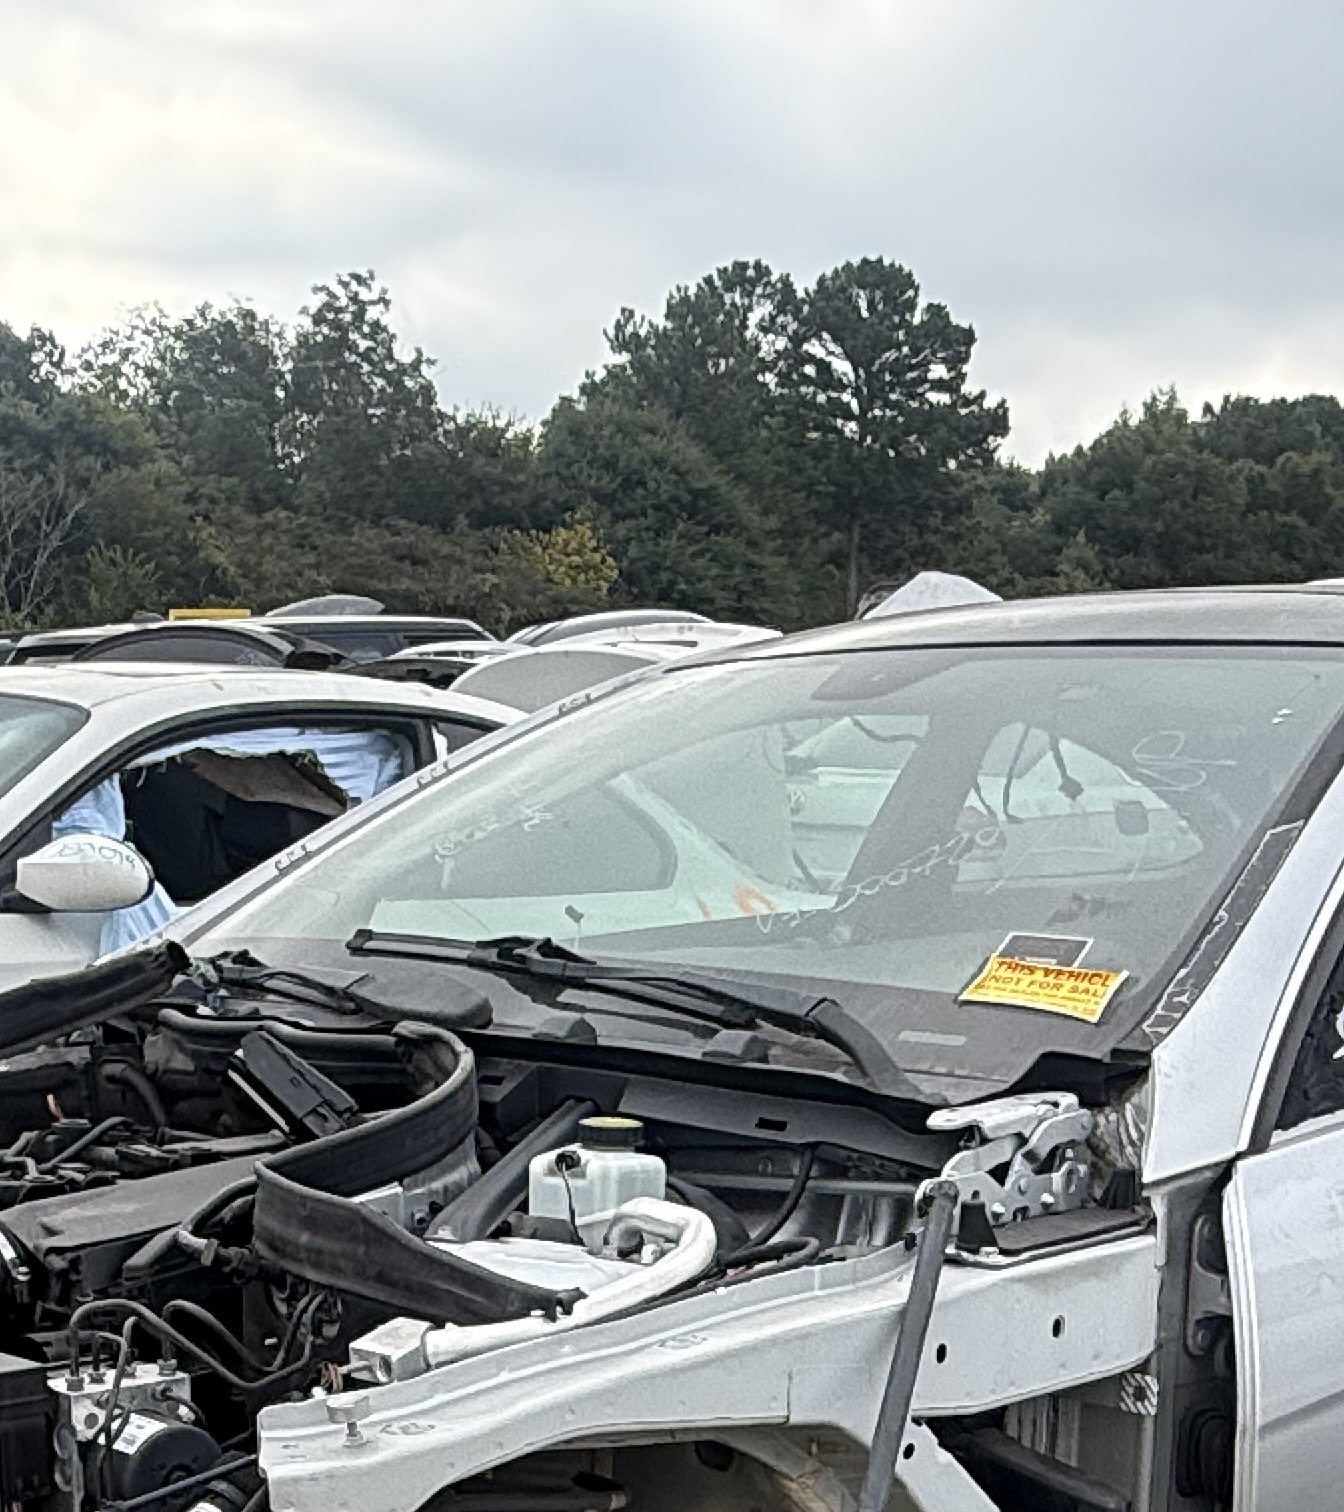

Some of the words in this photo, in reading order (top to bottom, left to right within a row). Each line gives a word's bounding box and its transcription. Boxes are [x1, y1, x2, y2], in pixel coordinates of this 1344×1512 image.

[988, 974, 1024, 987] NOT
[1026, 979, 1065, 992] FOR
[1067, 984, 1109, 999] SAL
[995, 960, 1037, 976] THIS
[1042, 966, 1113, 987] VEHICL
